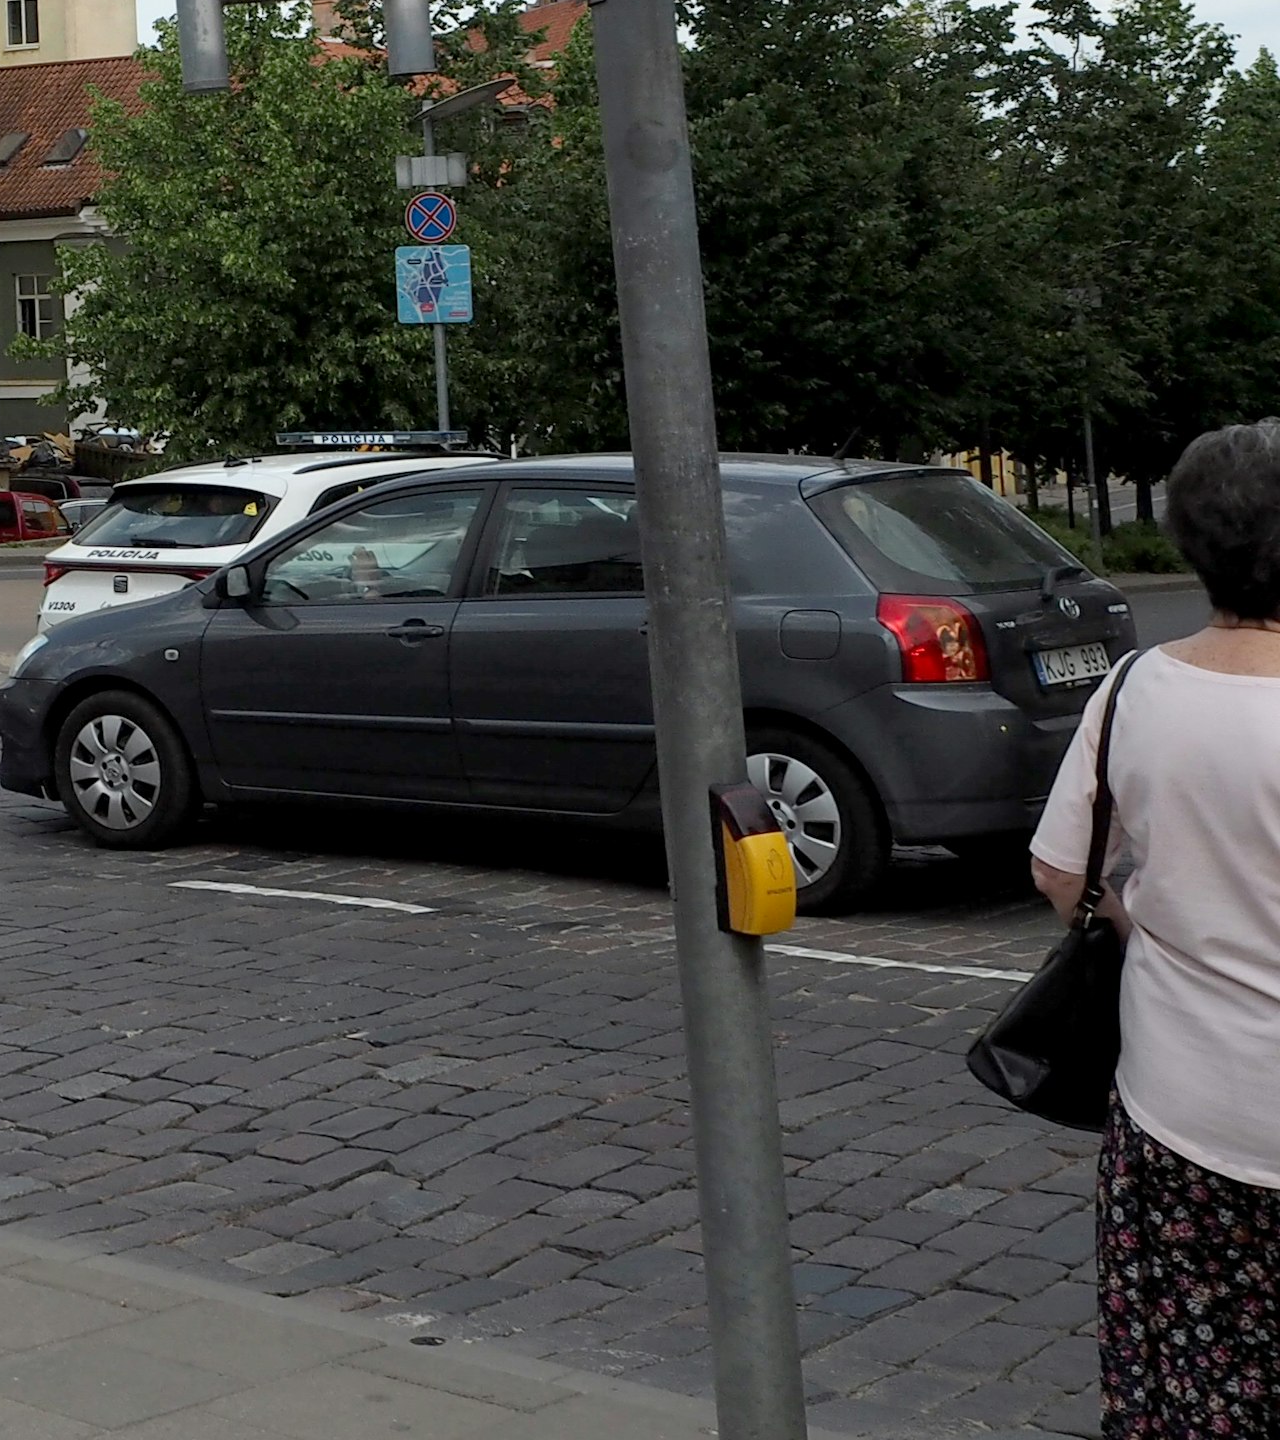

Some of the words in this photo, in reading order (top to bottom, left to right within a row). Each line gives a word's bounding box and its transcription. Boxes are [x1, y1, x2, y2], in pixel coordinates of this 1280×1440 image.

[322, 435, 386, 443] POLICIJA
[87, 550, 160, 560] POLICIJA
[48, 601, 77, 610] V1306
[1042, 650, 1076, 680] KJG
[1081, 646, 1108, 673] 993
